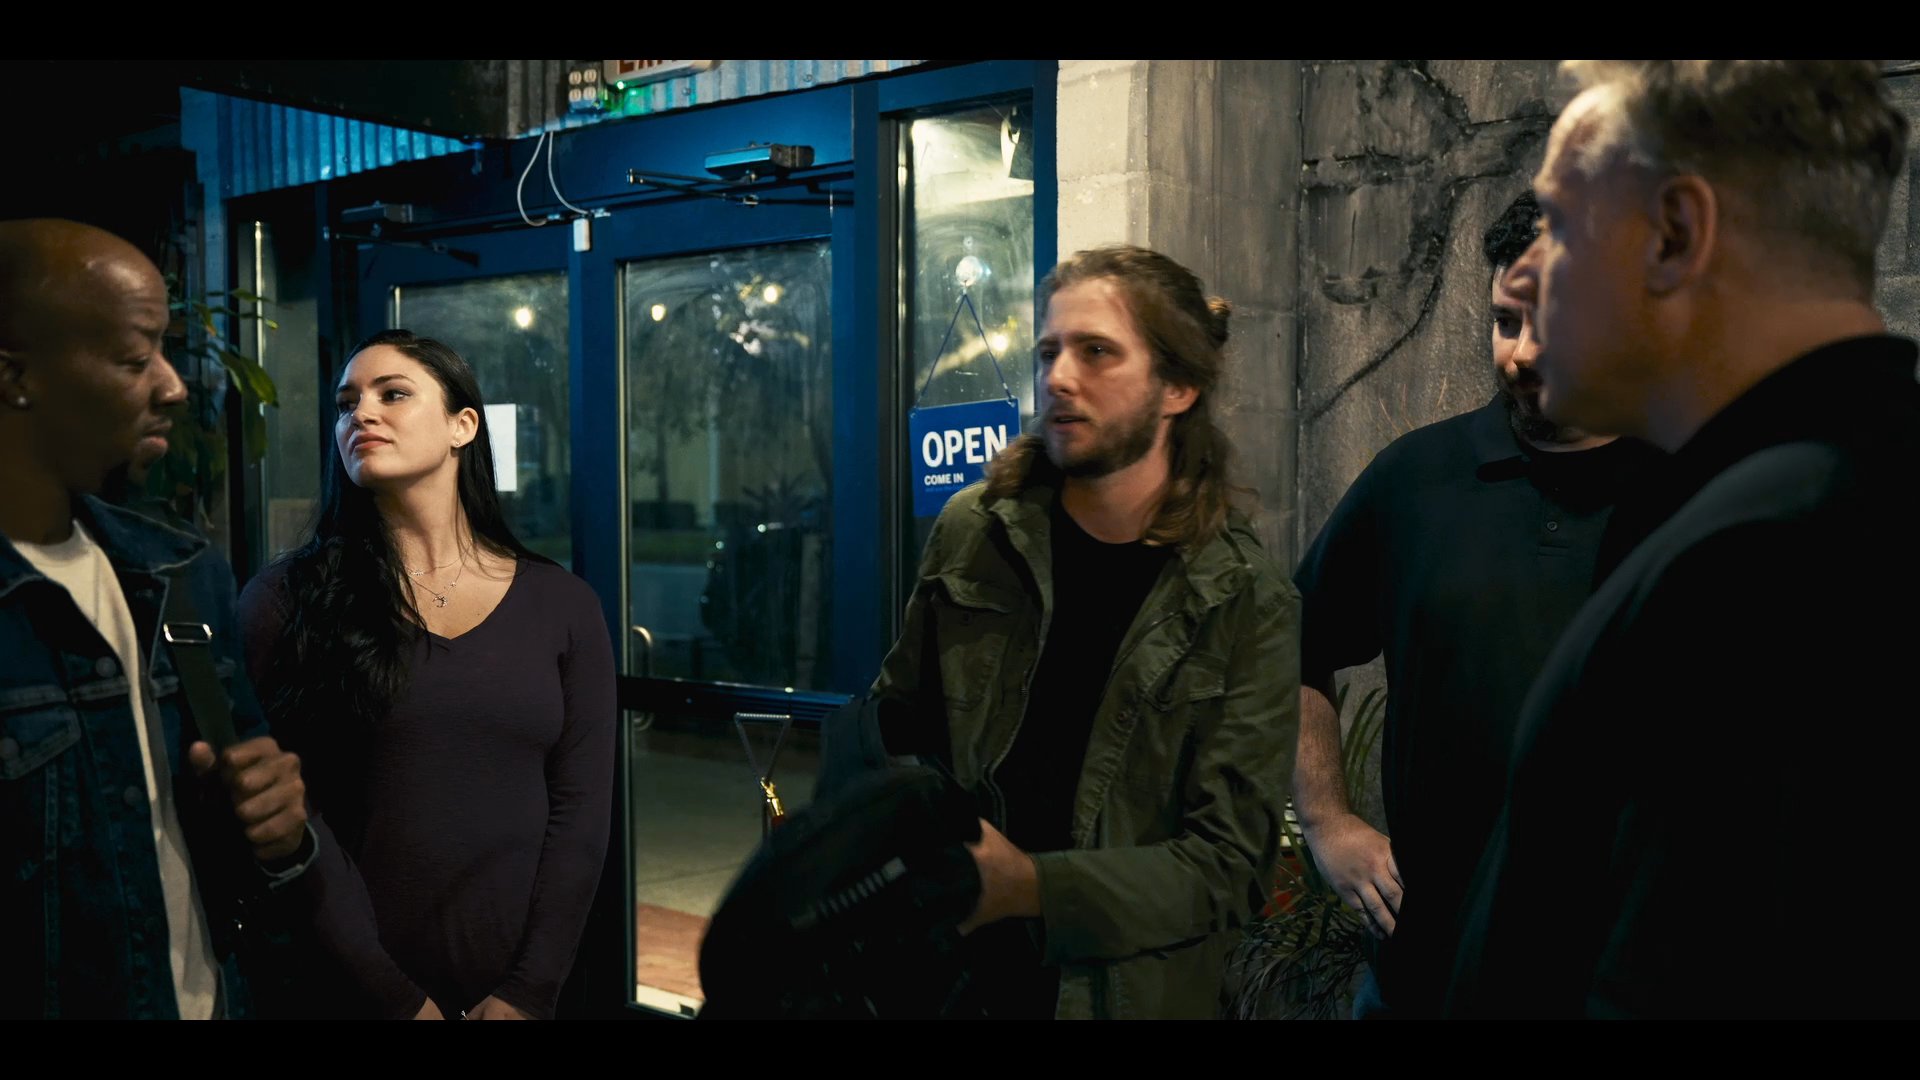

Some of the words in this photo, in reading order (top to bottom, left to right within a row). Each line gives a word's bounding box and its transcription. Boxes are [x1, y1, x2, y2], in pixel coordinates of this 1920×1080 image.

[922, 424, 1007, 468] OPEN
[924, 474, 952, 486] COME
[953, 472, 964, 483] IN
